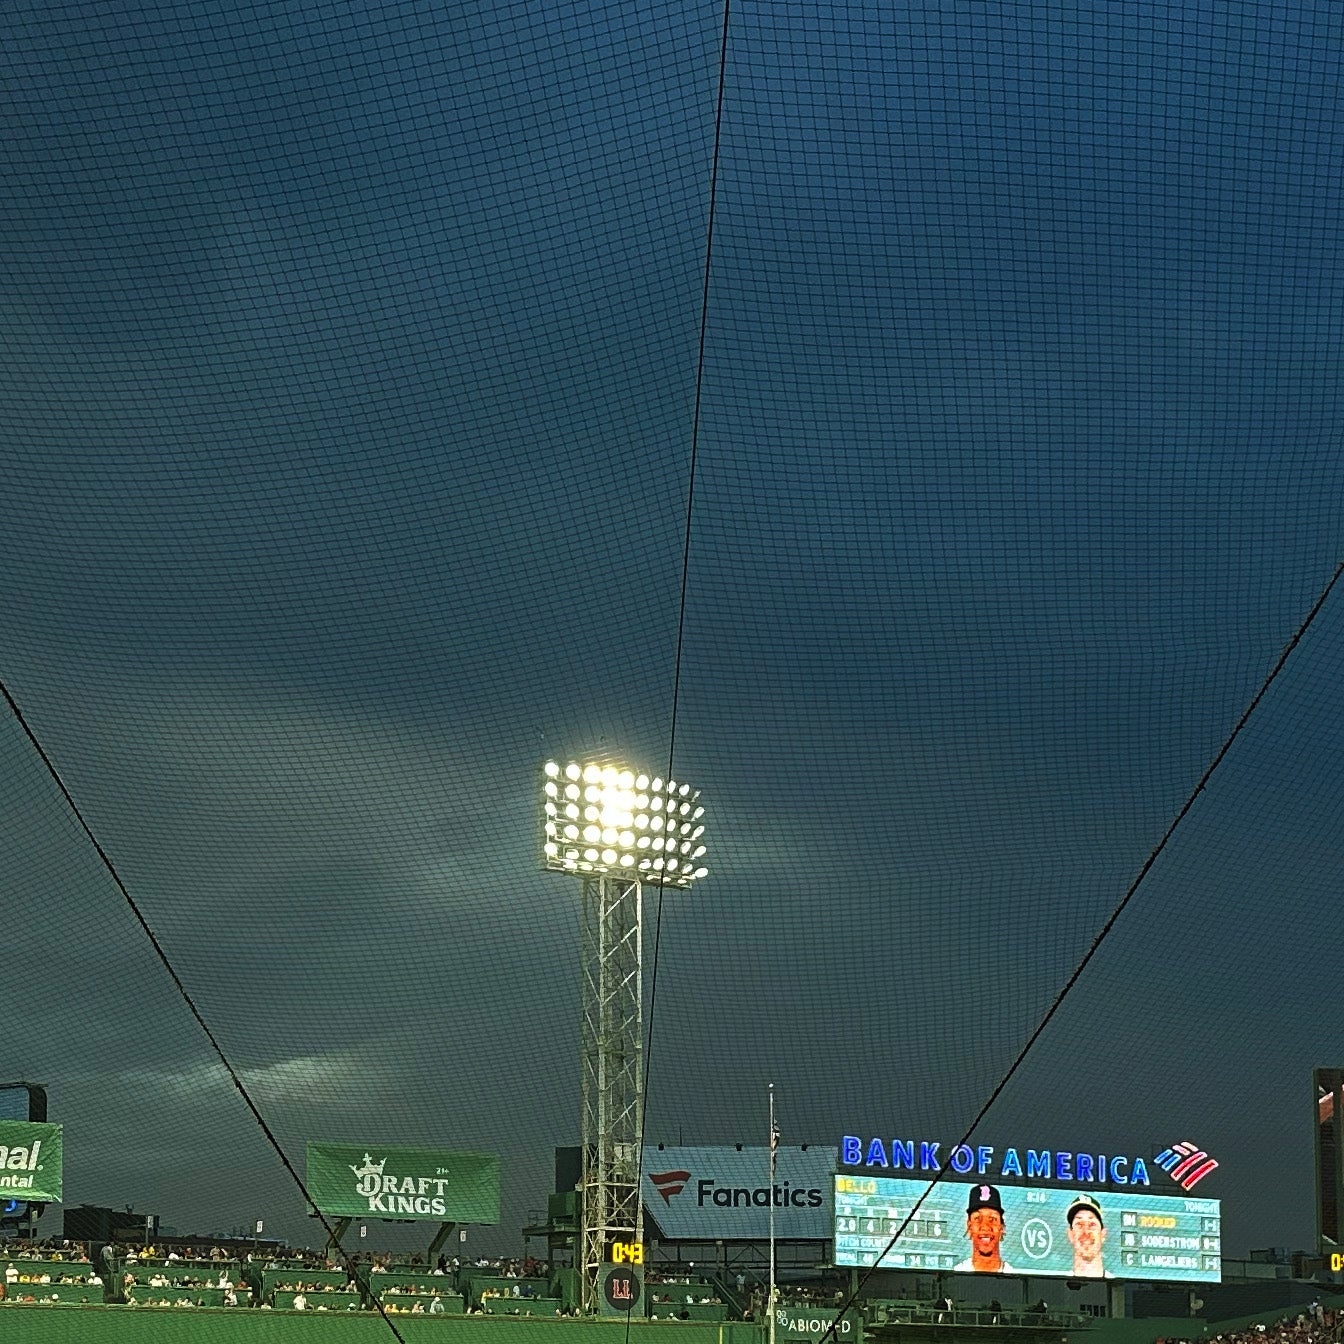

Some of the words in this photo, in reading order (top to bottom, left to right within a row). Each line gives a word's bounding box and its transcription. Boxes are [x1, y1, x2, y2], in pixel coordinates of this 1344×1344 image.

[842, 1135, 943, 1171] BANK
[950, 1143, 994, 1174] OF
[1001, 1148, 1151, 1186] AMERICA
[356, 1175, 449, 1197] DRAFT
[697, 1180, 823, 1208] Fanatics
[368, 1193, 447, 1215] KINGS
[1026, 1229, 1047, 1249] VS
[613, 1242, 643, 1264] 0:43
